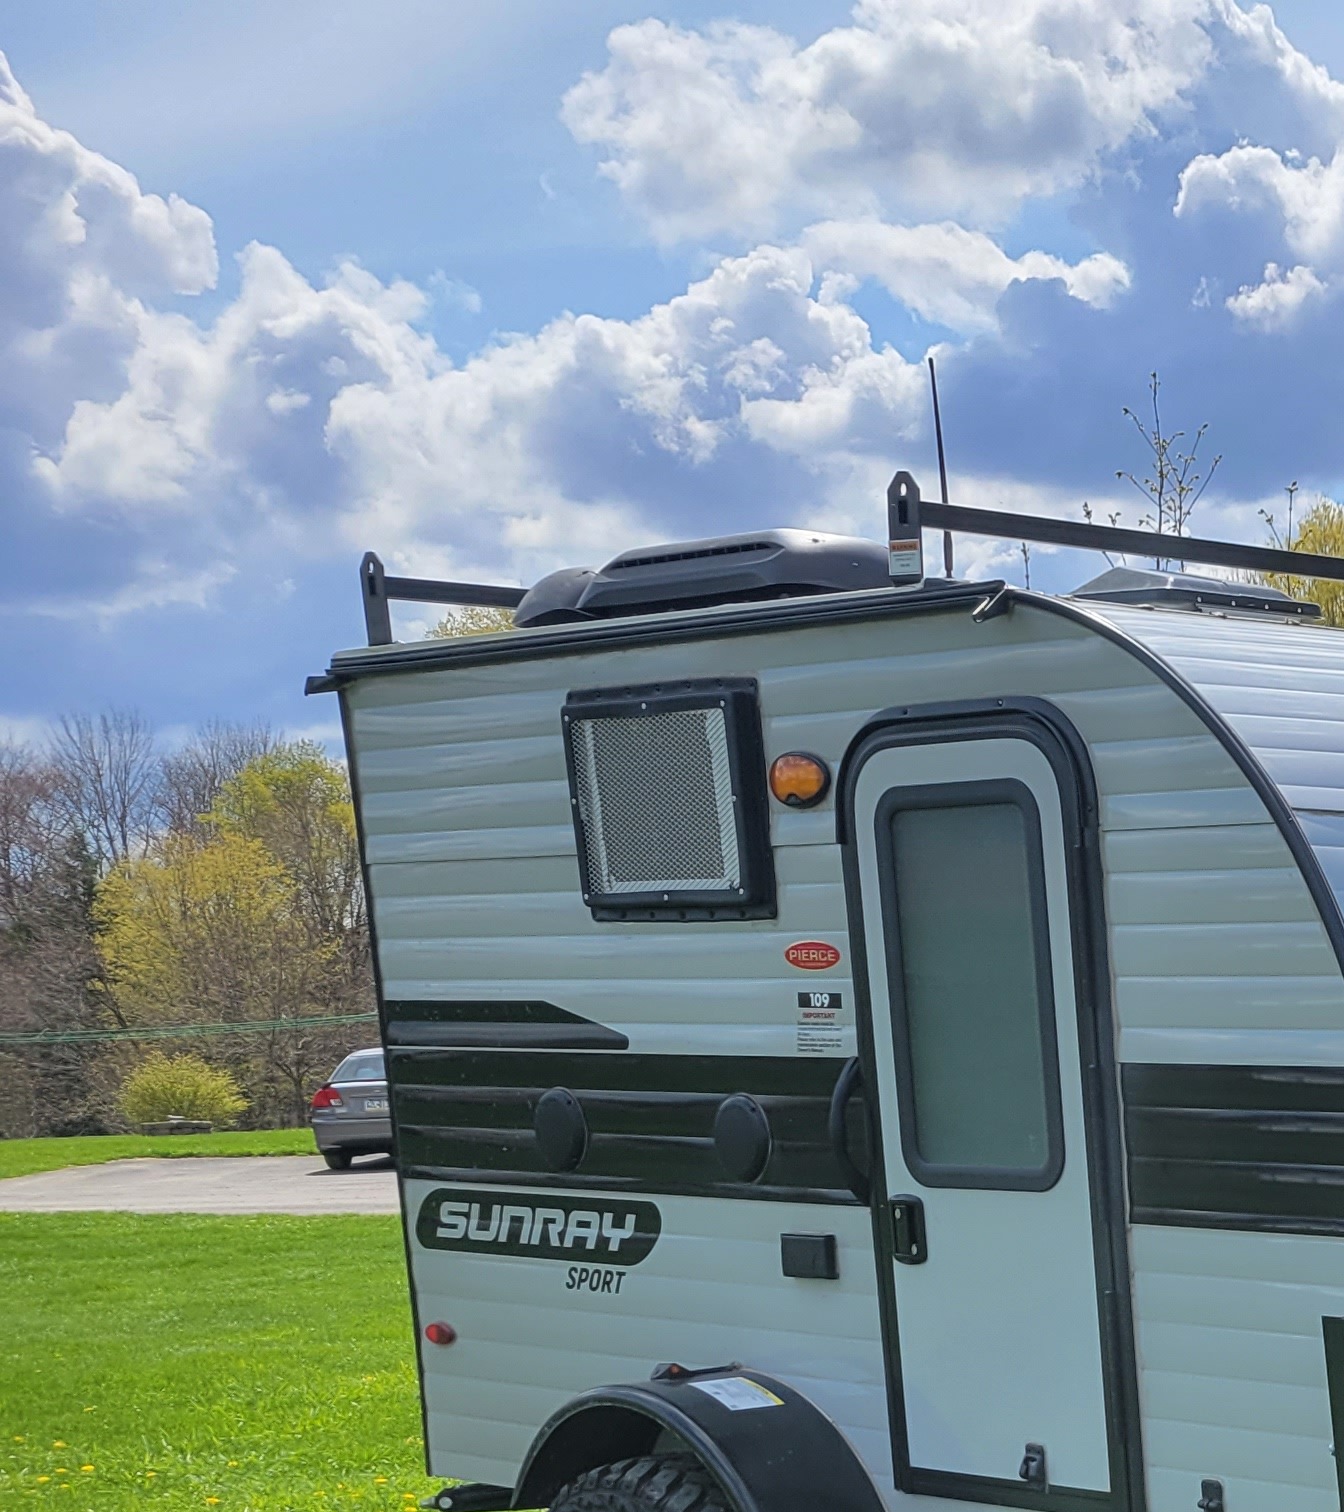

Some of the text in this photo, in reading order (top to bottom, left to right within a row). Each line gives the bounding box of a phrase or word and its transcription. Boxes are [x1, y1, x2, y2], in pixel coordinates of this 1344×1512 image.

[789, 949, 836, 961] PIERCE
[809, 993, 830, 1008] 109
[436, 1201, 637, 1252] SUNRAY
[565, 1266, 627, 1295] SPORT
